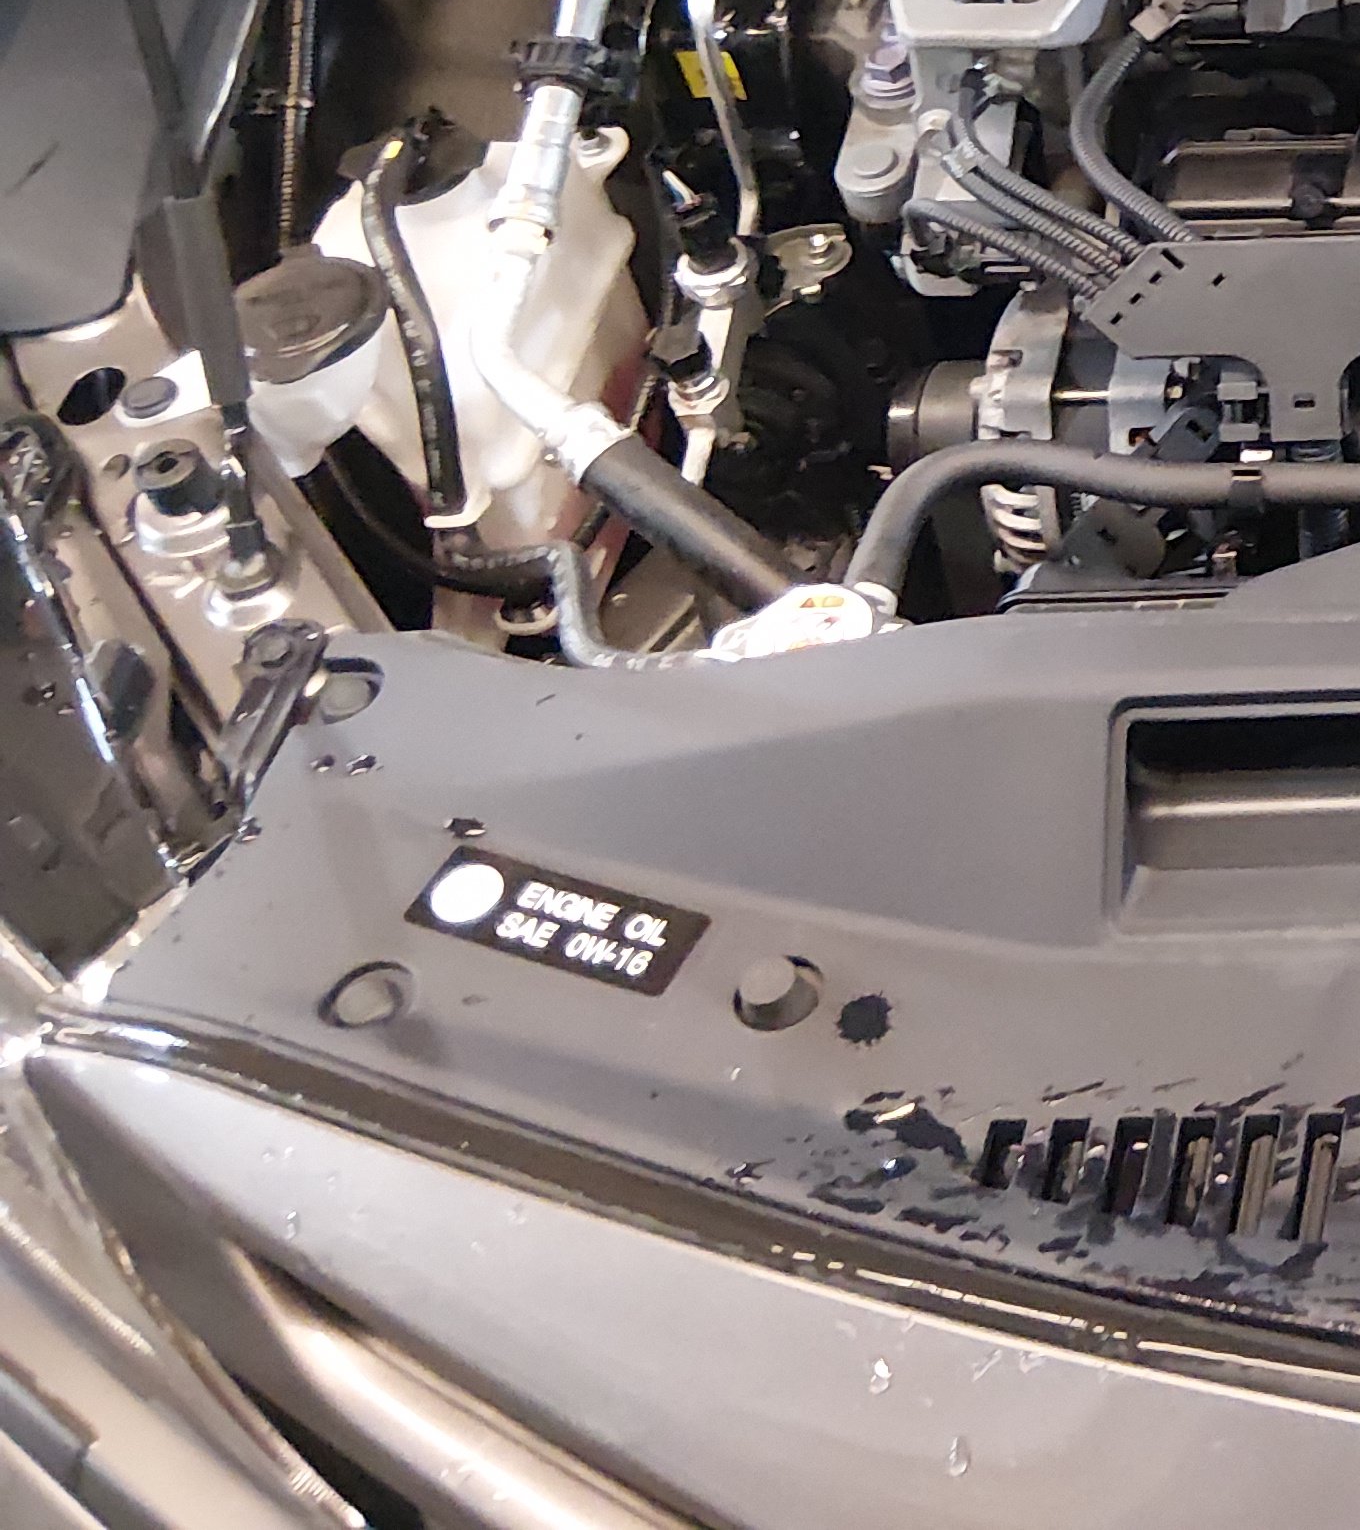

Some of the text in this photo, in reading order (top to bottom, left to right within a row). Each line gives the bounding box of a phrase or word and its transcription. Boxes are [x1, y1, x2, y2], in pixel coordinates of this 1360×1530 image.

[496, 911, 653, 976] SAE 0W-16
[517, 881, 670, 947] ENGINE OIL
